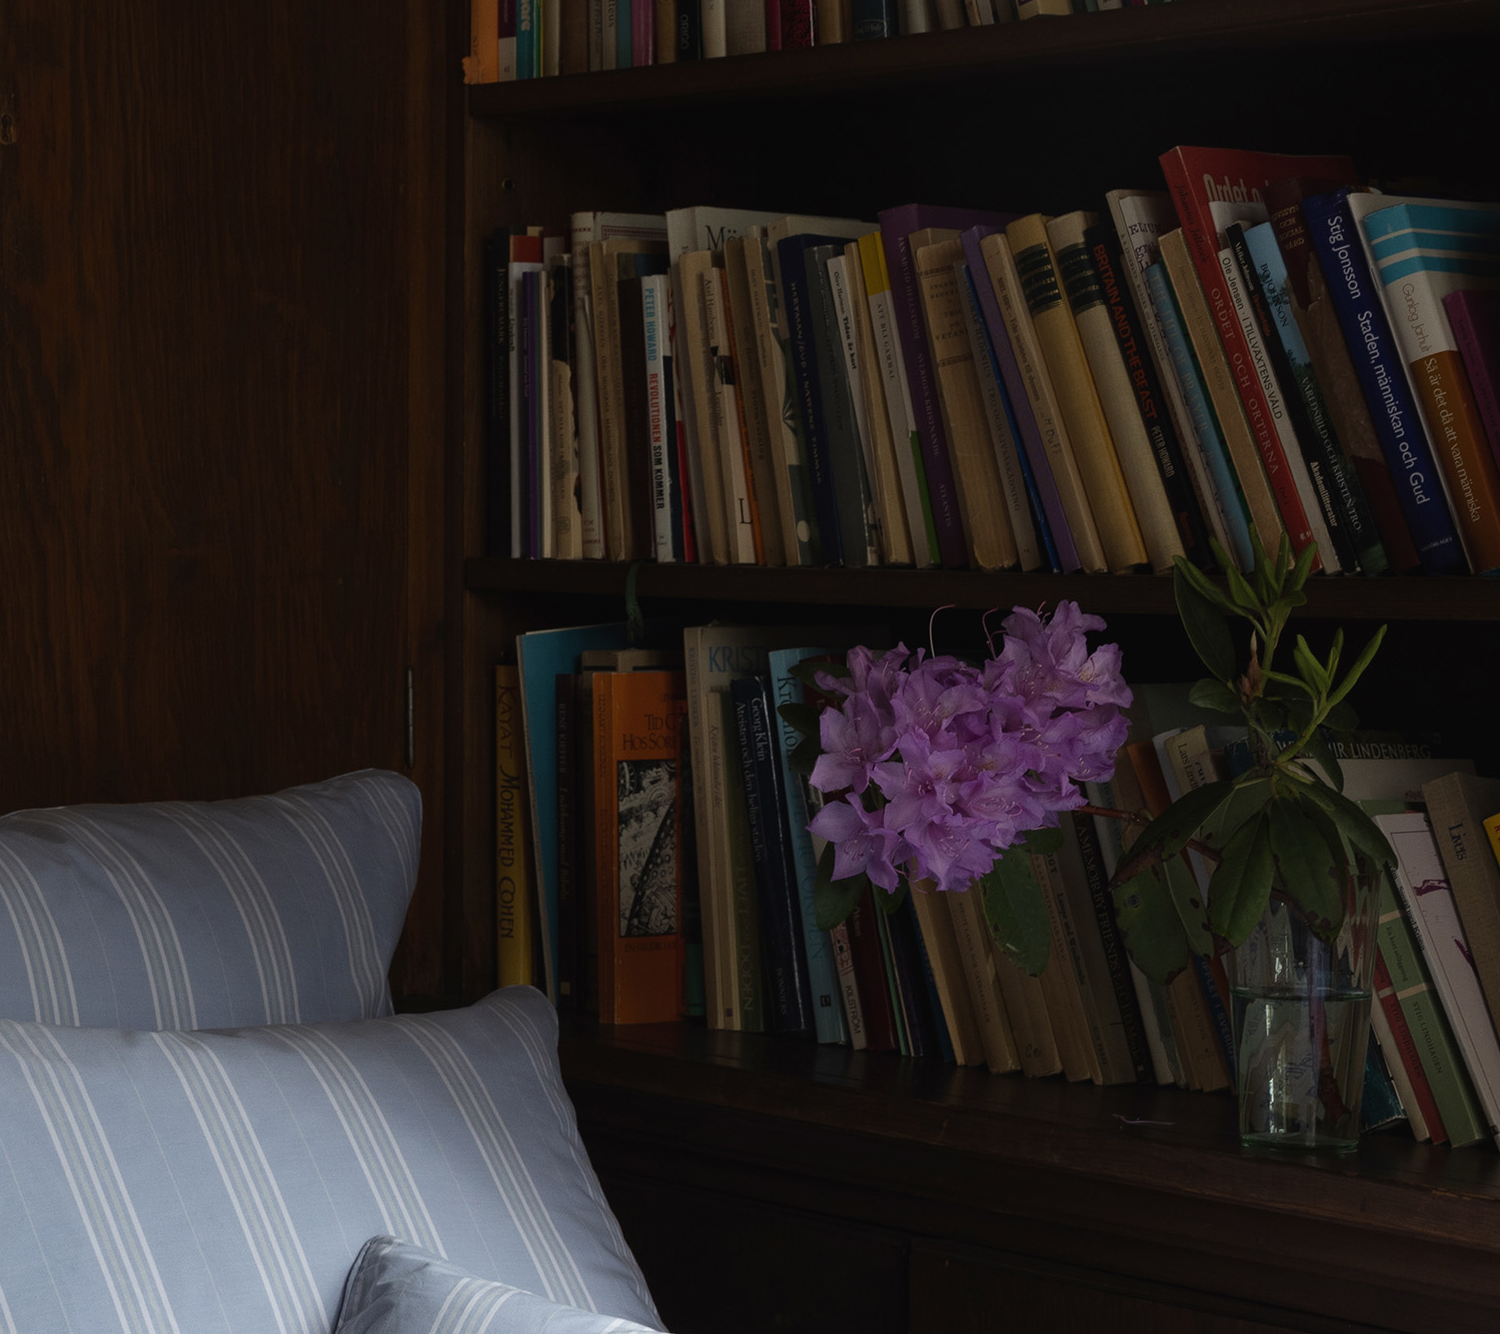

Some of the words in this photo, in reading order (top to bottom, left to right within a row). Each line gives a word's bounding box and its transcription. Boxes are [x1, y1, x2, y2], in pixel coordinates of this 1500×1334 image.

[897, 237, 909, 254] JAN
[1325, 215, 1346, 244] Stig
[899, 255, 913, 283] ARVID
[1330, 243, 1364, 300] Jonsson
[644, 288, 655, 319] PETER
[876, 303, 886, 321] ATT
[902, 284, 921, 341] HELLSTRÖM
[1401, 282, 1422, 323] Gunlög
[645, 320, 657, 361] HOWARD
[879, 322, 889, 339] BLI
[1355, 310, 1382, 366] Staden,
[882, 340, 896, 382] GAMMAL
[915, 353, 930, 398] SVERIGES
[1422, 357, 1439, 374] Så
[1428, 373, 1442, 388] är
[1431, 387, 1449, 408] det
[649, 373, 661, 443] REVOLUTIONEN
[1373, 364, 1406, 439] människan
[1438, 408, 1454, 425] då
[924, 399, 941, 459] KRISTNANDE
[1444, 425, 1460, 443] att
[653, 445, 663, 467] SOM
[1300, 375, 1329, 442] VÄRLDSBILD
[1322, 440, 1338, 464] OCH
[1330, 462, 1353, 512] KRISTEN
[1346, 508, 1364, 532] TRO
[1398, 441, 1418, 469] och
[1448, 441, 1465, 468] vara
[655, 469, 665, 509] KOMMER
[1408, 471, 1431, 506] Gud
[1456, 467, 1483, 523] människa
[498, 684, 518, 759] KAYAT
[734, 701, 751, 746] Ateisten
[749, 697, 766, 733] Georg
[739, 747, 753, 769] och
[753, 732, 767, 762] Klein
[1351, 742, 1431, 759] LINDENBERG
[743, 770, 756, 792] den
[498, 766, 521, 868] MOHAMMED
[745, 793, 760, 825] heliga
[751, 826, 764, 863] staden
[499, 876, 515, 939] COHEN
[735, 867, 749, 913] LIVET
[738, 944, 754, 1011] DÖDEN
[845, 985, 861, 1035] KILSTRÖM
[1412, 1001, 1424, 1022] STIG
[1417, 1022, 1443, 1075] LINDHAGEN
